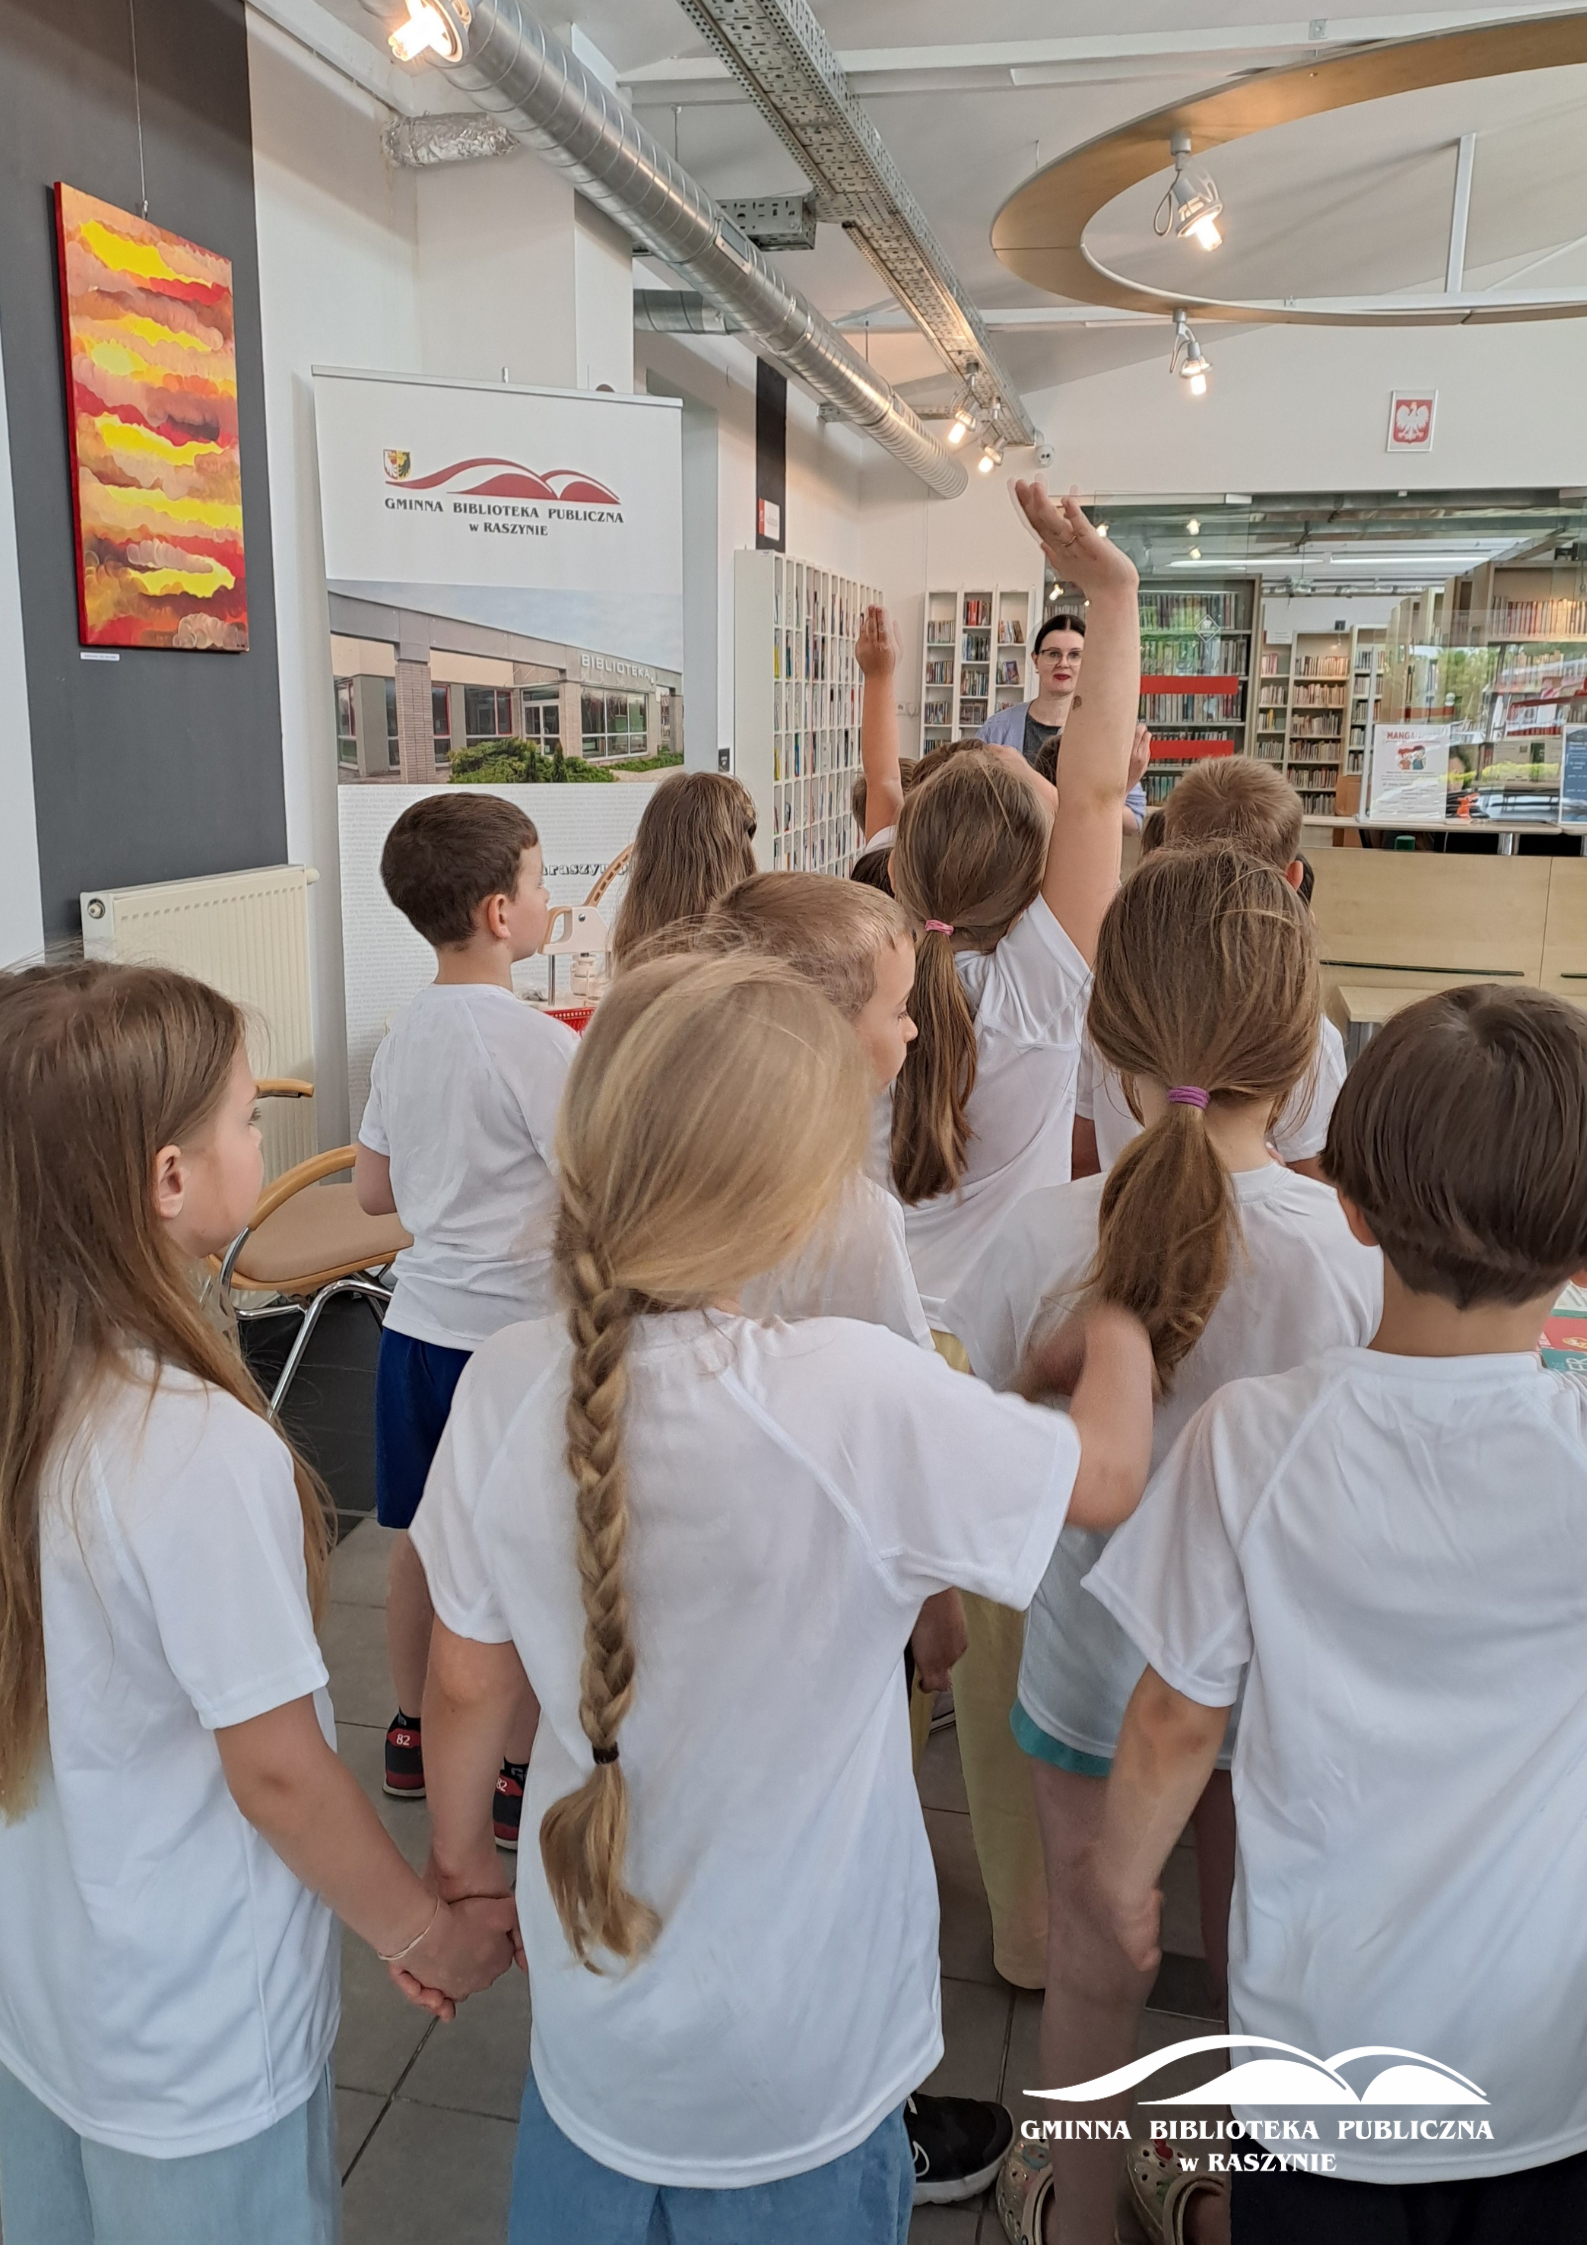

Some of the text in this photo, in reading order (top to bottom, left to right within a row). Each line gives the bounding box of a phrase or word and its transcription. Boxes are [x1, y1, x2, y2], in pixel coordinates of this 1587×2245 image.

[385, 497, 624, 523] GMINNA BIBLIOTEKA PUBLICZNA
[469, 522, 549, 536] w RASZYNIE
[581, 654, 650, 679] BIBLIOTEKA
[396, 1733, 411, 1746] 82
